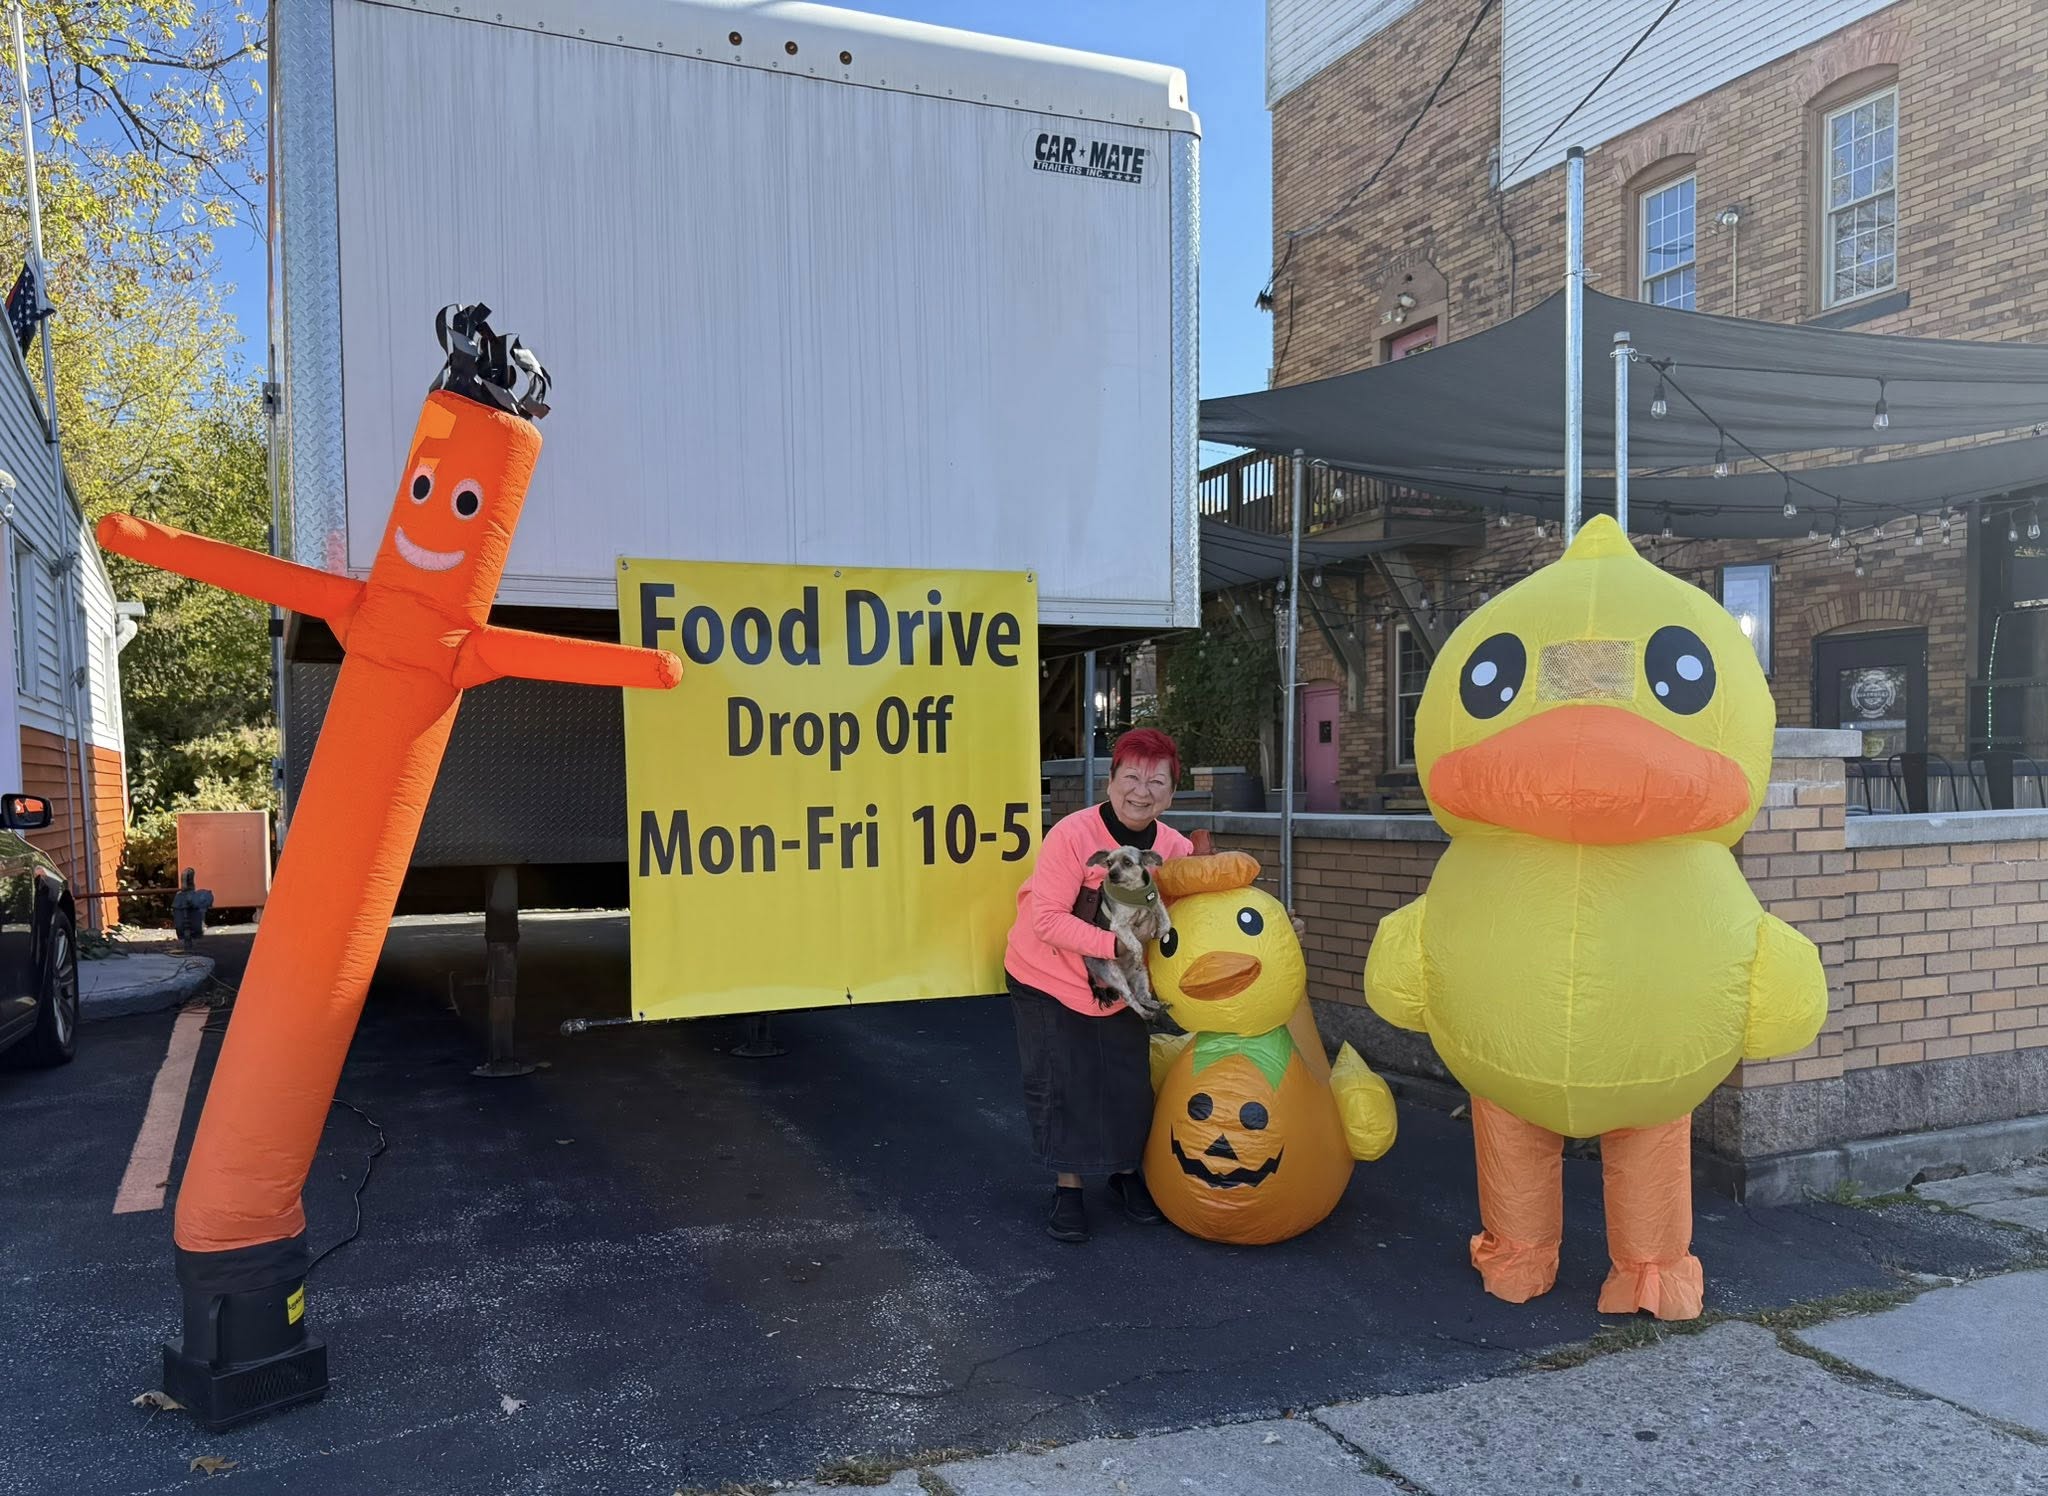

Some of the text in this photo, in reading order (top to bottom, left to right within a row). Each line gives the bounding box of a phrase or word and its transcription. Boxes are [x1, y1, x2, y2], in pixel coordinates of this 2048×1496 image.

[1035, 133, 1145, 174] CAR MATE
[1036, 161, 1105, 178] TRAILERS INC.
[640, 583, 1020, 666] Food Drive
[728, 695, 953, 771] Drop Off
[639, 803, 1030, 876] Mon-Fri 10-5
